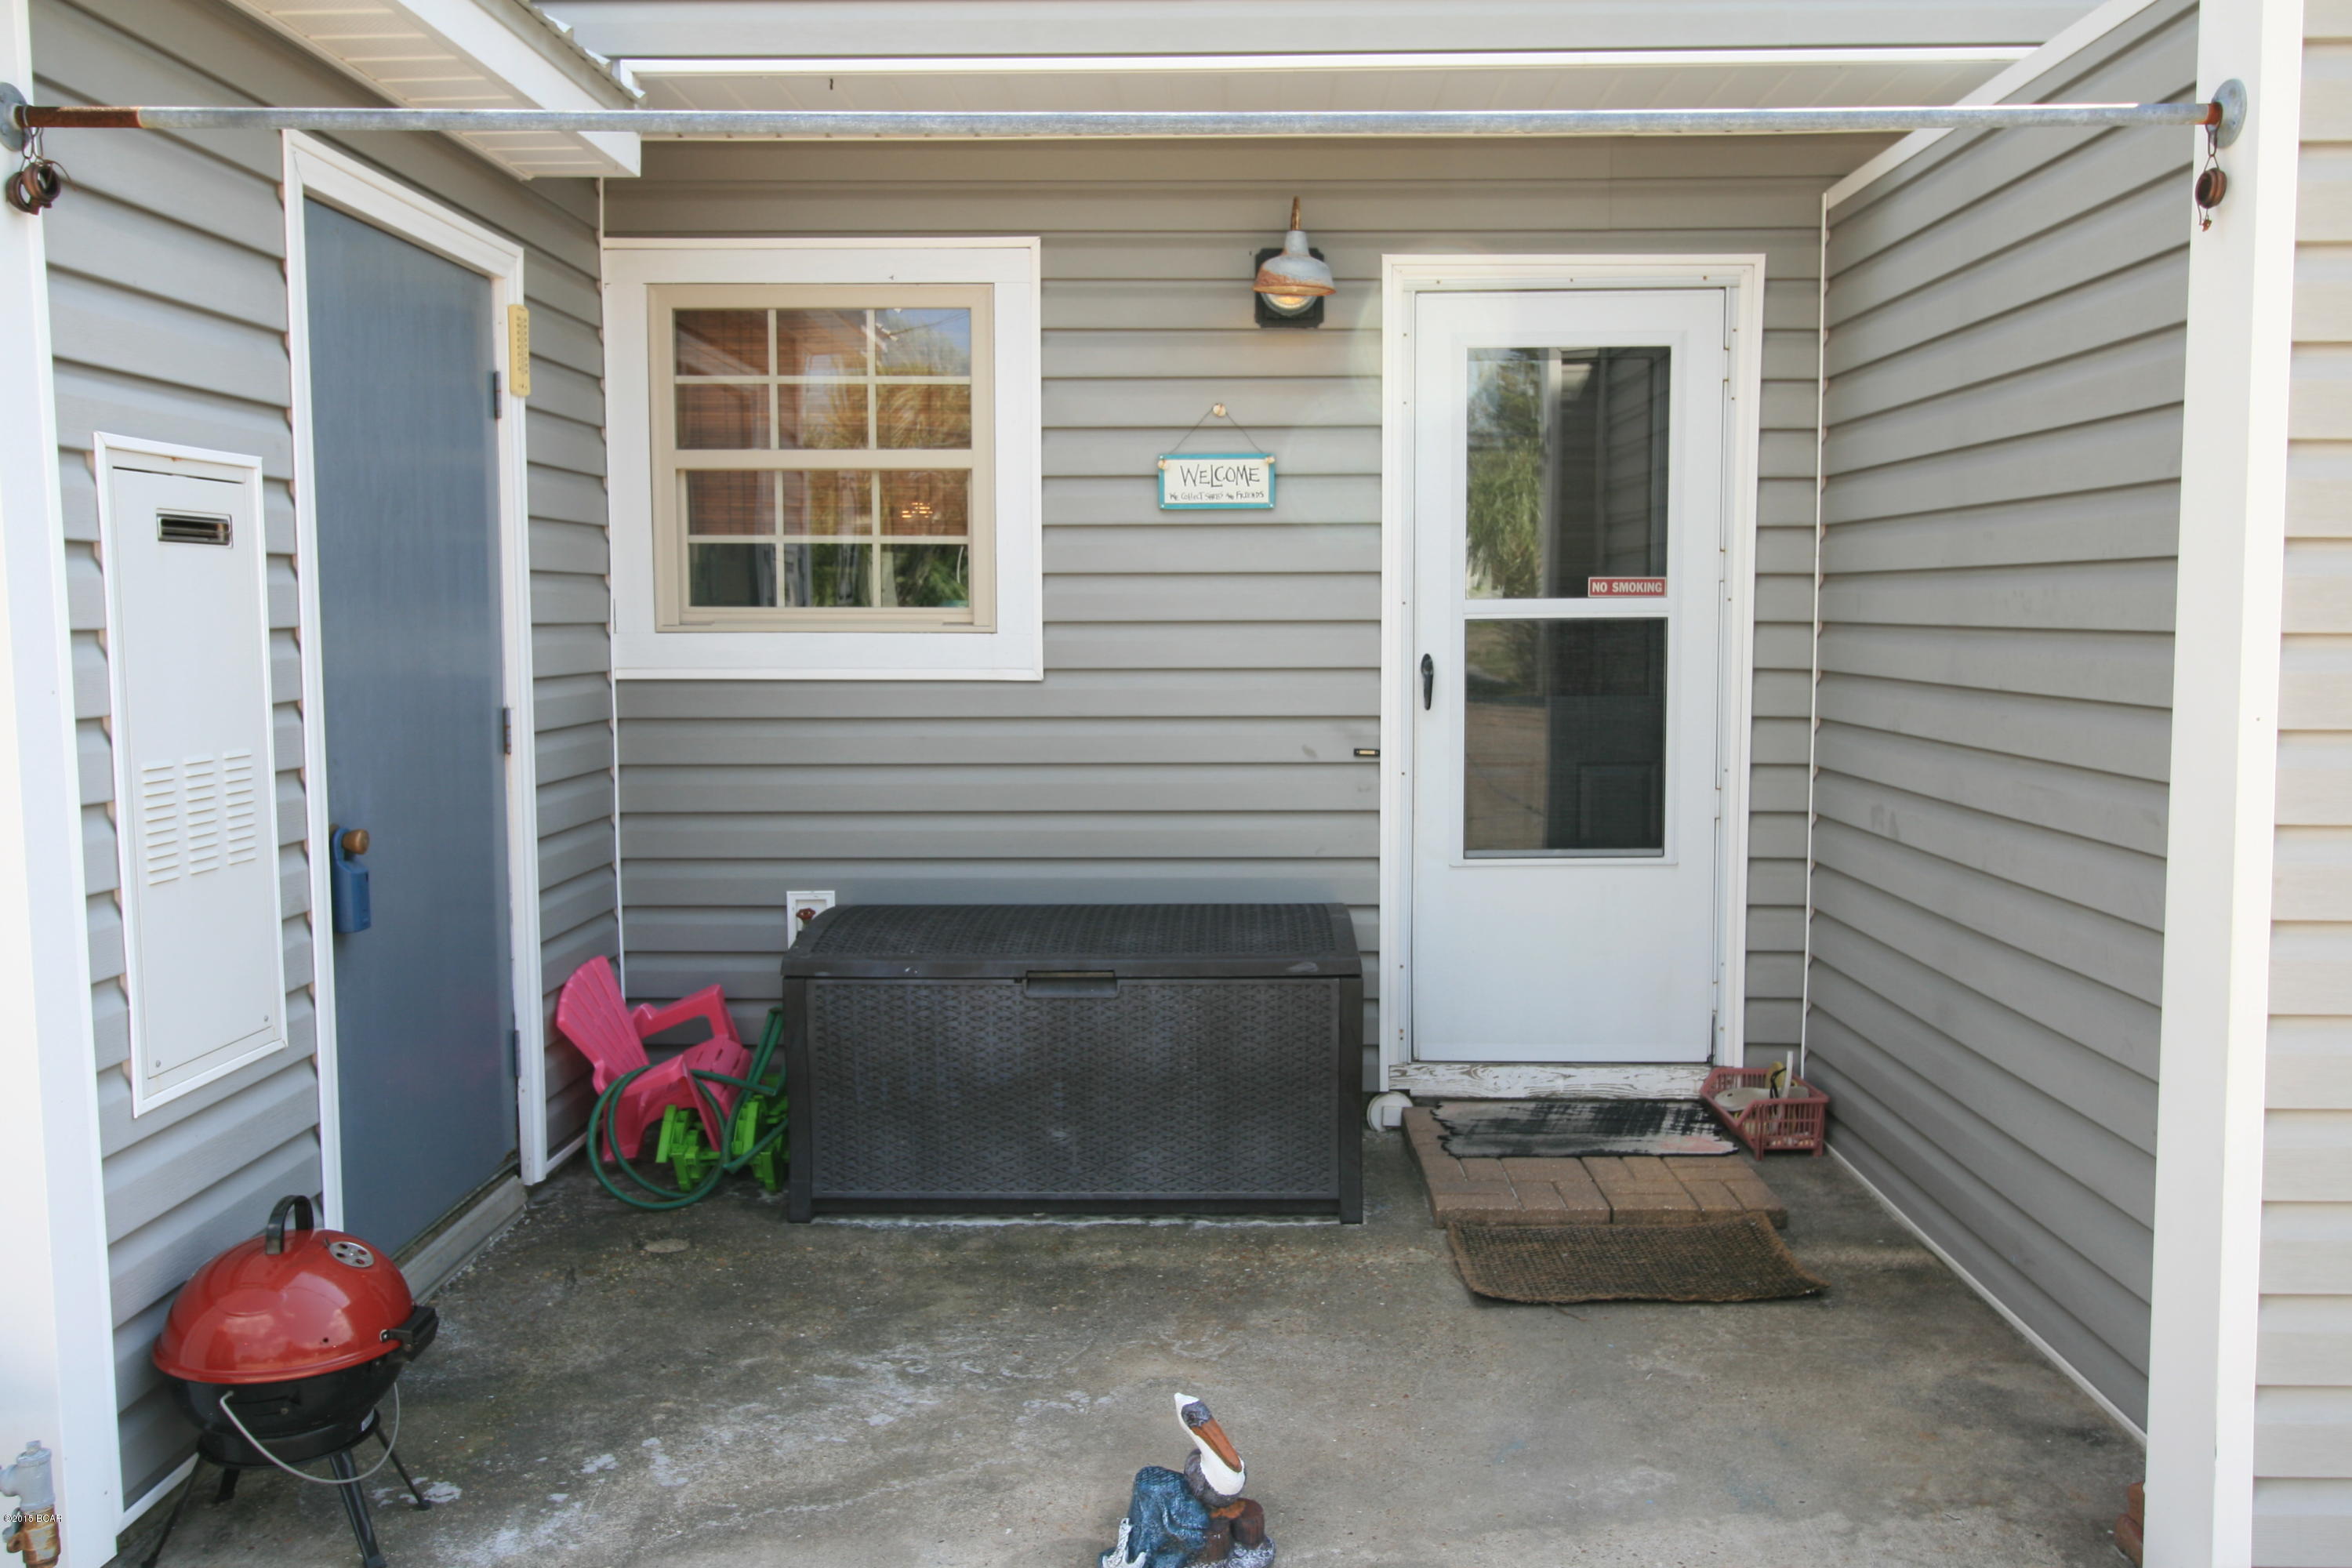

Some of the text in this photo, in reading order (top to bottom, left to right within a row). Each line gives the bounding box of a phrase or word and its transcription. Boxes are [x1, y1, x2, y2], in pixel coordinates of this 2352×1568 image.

[1180, 464, 1260, 488] WELCOME
[1592, 582, 1662, 593] NO SMOKING
